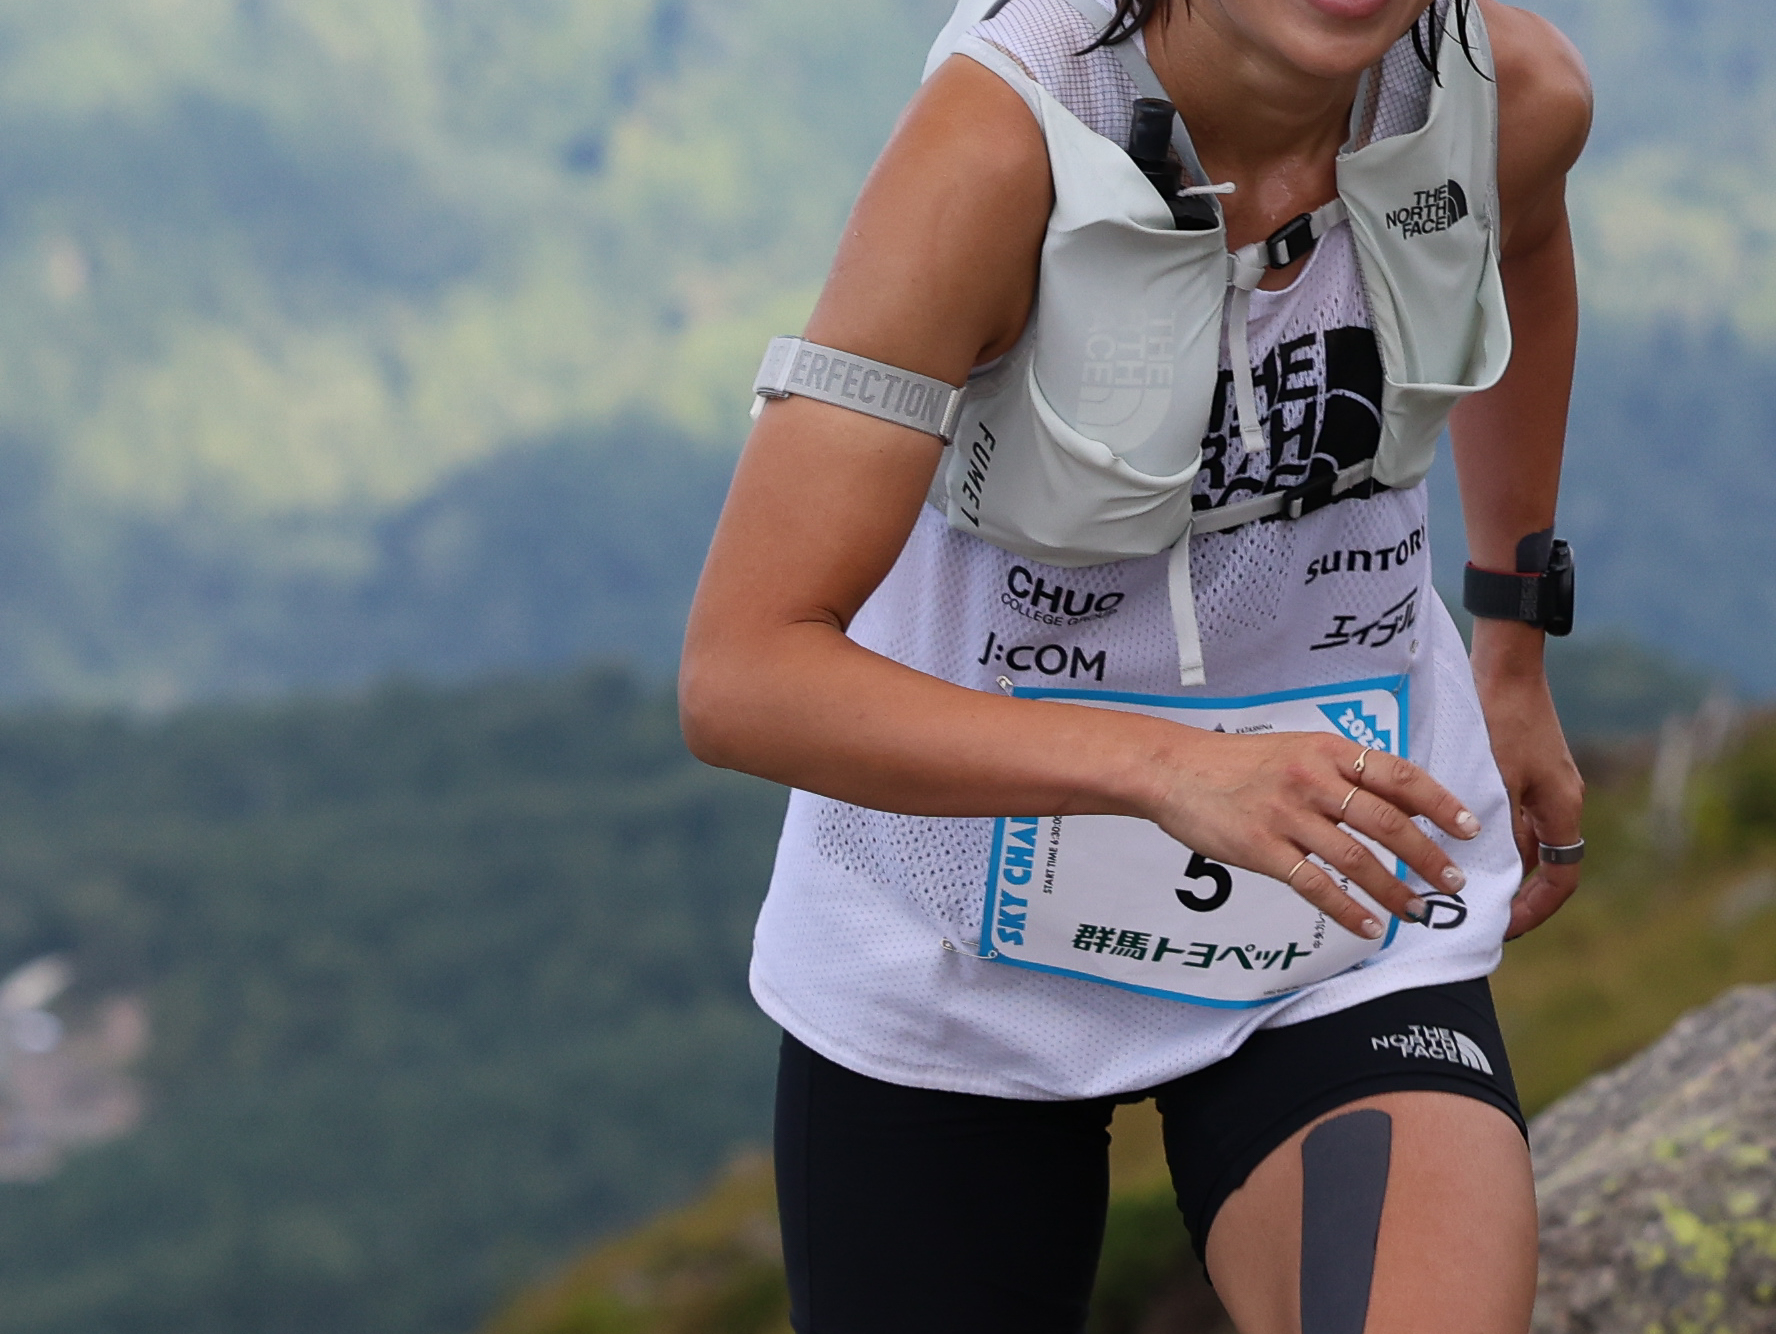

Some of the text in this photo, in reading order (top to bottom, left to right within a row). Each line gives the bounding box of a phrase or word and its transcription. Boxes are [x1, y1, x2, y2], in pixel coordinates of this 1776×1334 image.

[1413, 184, 1448, 206] THE
[1385, 199, 1447, 229] NORTH
[1402, 215, 1446, 240] FACE
[790, 349, 943, 424] ERFECTION
[962, 421, 997, 511] FUME
[1304, 524, 1425, 585] SUNTOR
[1007, 565, 1125, 616] CHUO
[1001, 592, 1064, 627] COLLEGE
[978, 631, 1107, 682] J:COM
[1047, 847, 1059, 869] TIME
[1043, 868, 1056, 895] START
[997, 888, 1029, 947] SKY
[1071, 923, 1313, 971] 群馬トヨペット
[1370, 1033, 1458, 1051] NORTH
[1408, 1024, 1450, 1041] THE
[1401, 1043, 1460, 1063] FACE
